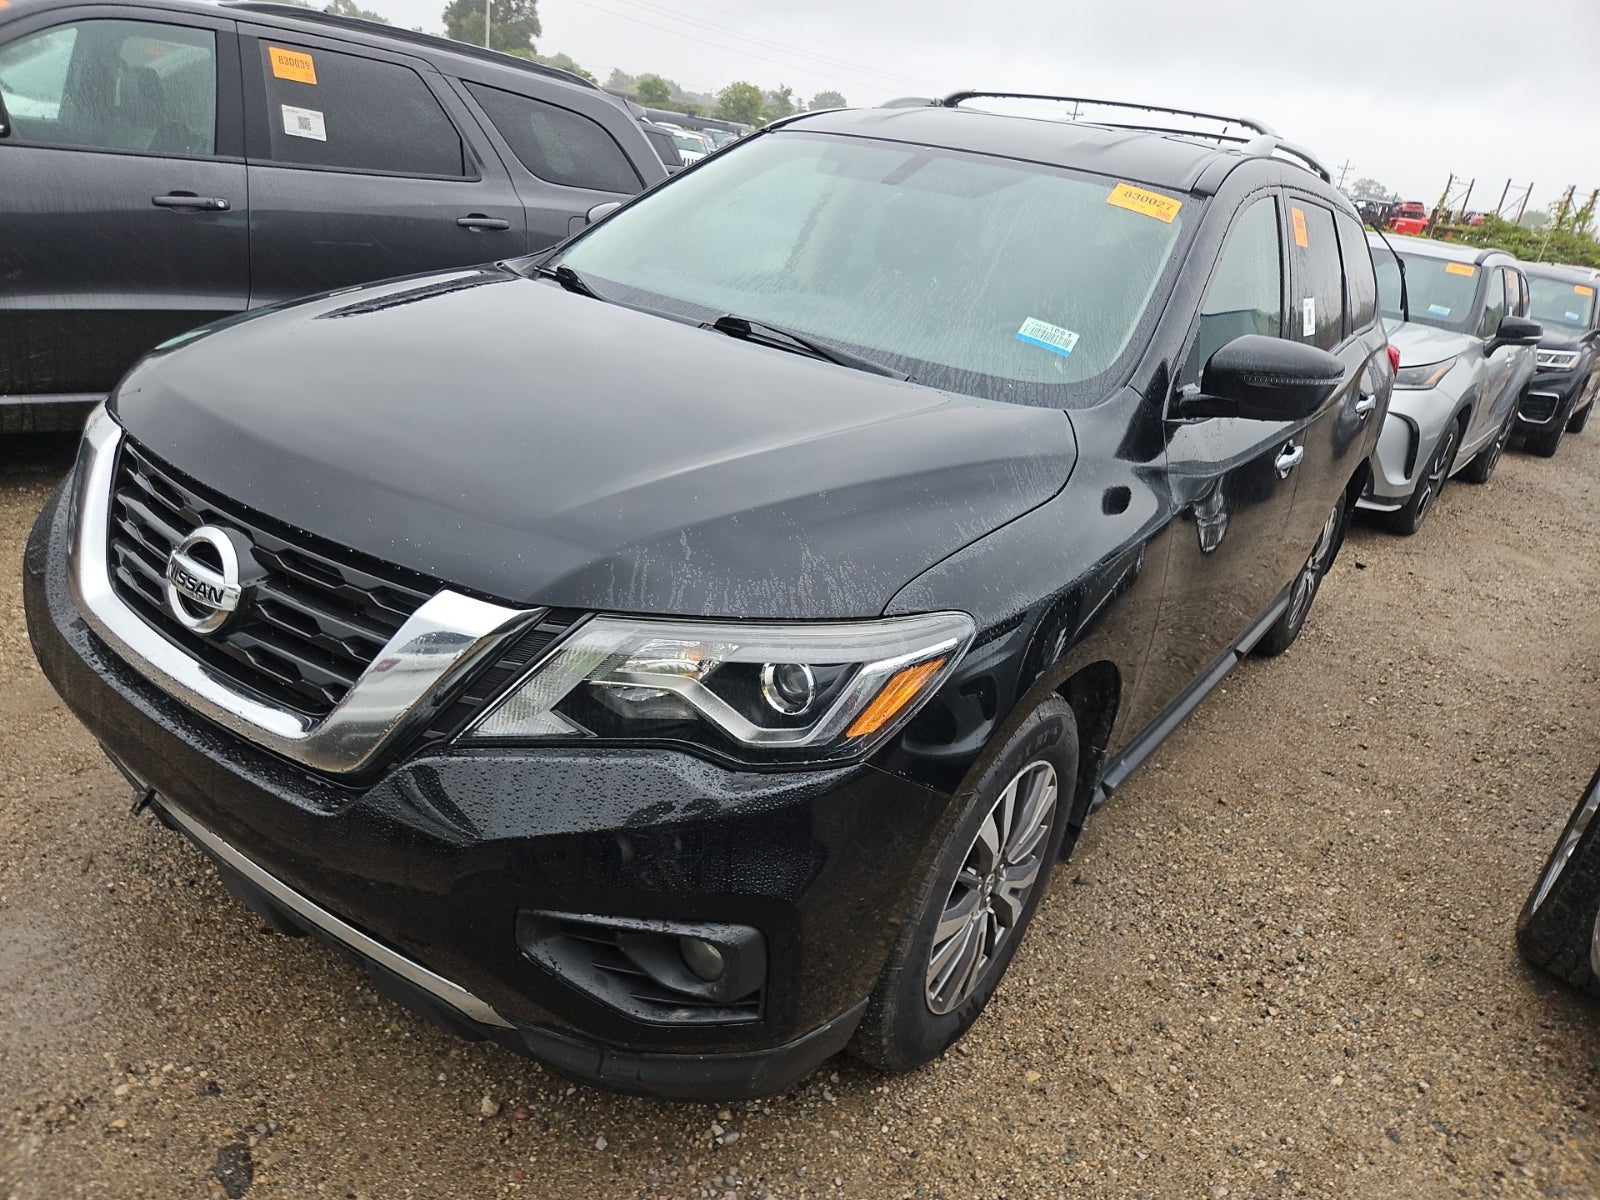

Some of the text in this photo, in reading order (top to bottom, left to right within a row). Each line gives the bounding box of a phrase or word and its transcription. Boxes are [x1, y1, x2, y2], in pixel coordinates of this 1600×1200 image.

[278, 55, 310, 70] 830039
[1123, 190, 1174, 211] 830027
[168, 562, 224, 604] NISSAN
